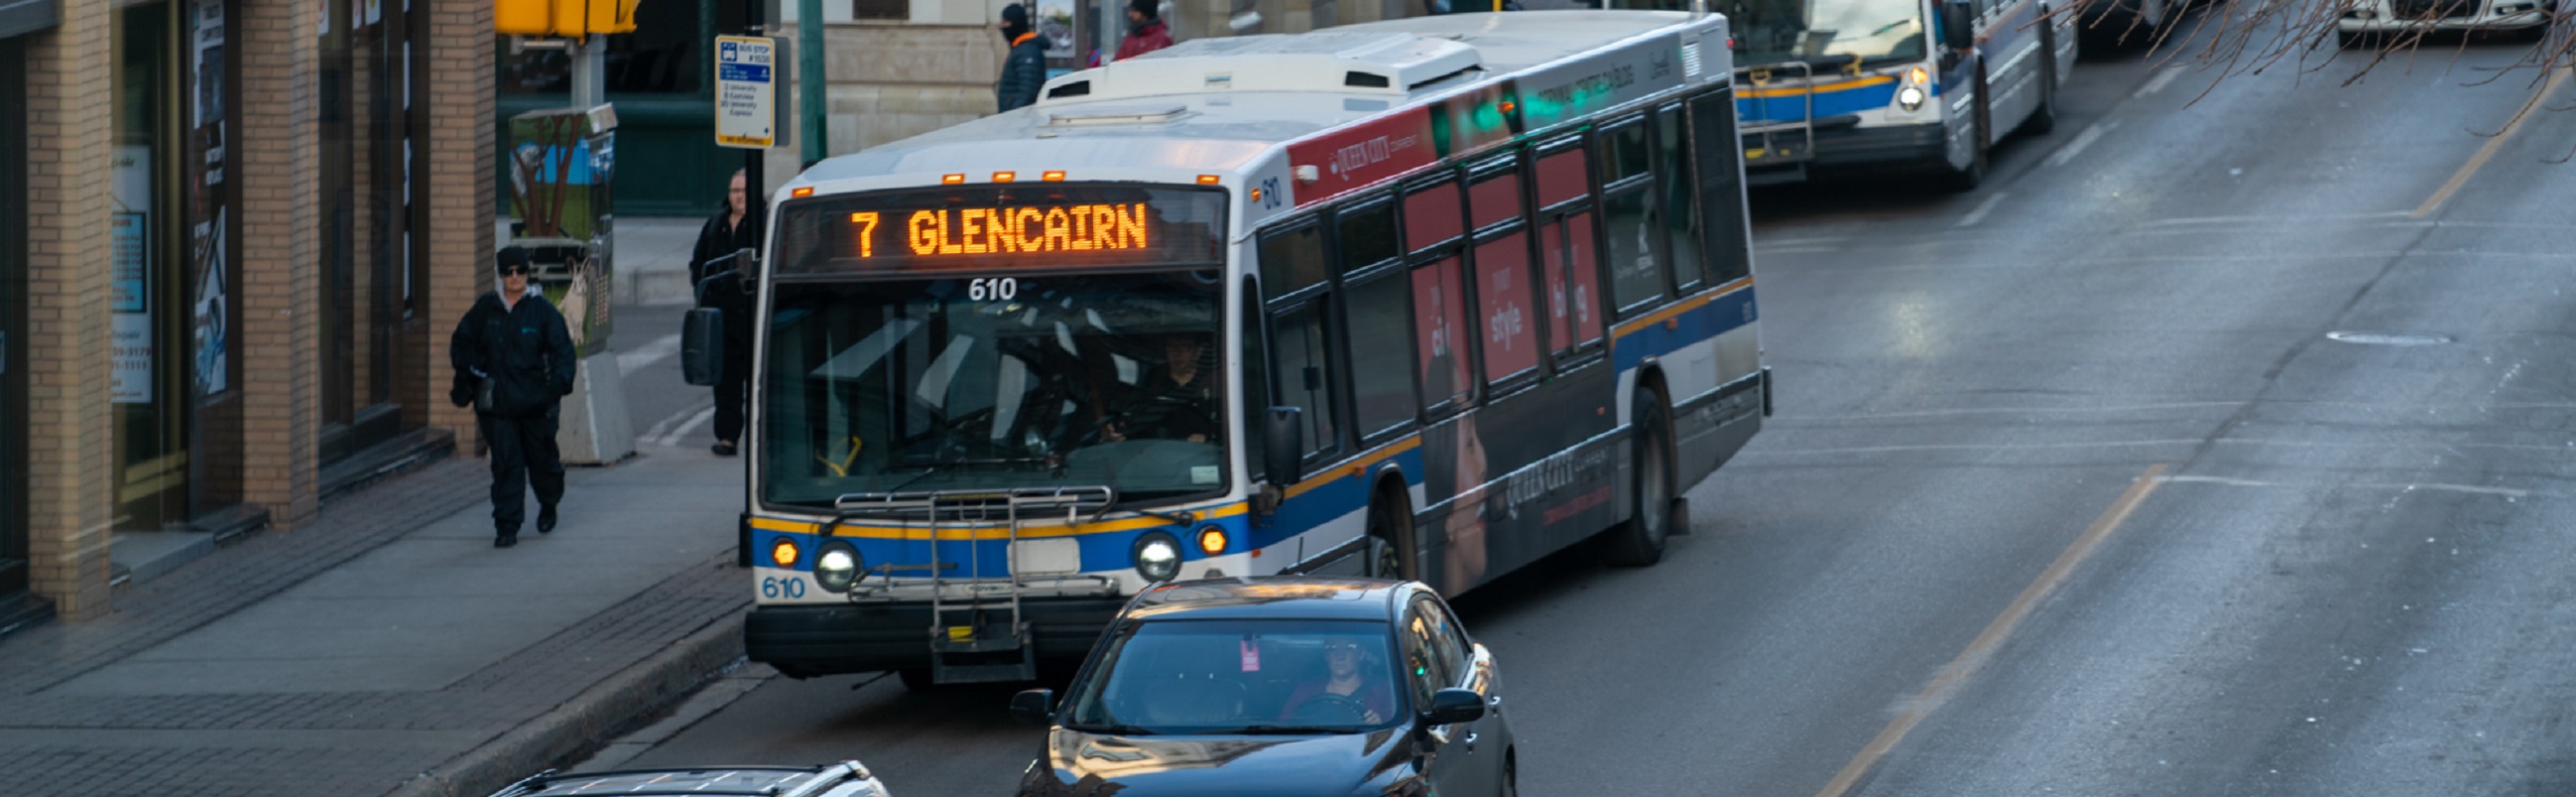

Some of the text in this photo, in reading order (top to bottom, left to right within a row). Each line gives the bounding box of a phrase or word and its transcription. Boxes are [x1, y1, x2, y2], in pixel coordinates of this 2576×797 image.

[739, 44, 771, 55] BUS STOP
[729, 83, 757, 93] University
[729, 101, 757, 110] University
[1337, 141, 1369, 182] QUEEN
[1368, 134, 1391, 164] CITY
[1264, 175, 1282, 210] 610
[851, 202, 1147, 259] 7 GLENCAIRN
[968, 277, 1017, 301] 610
[1491, 300, 1523, 351] style
[761, 575, 805, 600] 610
